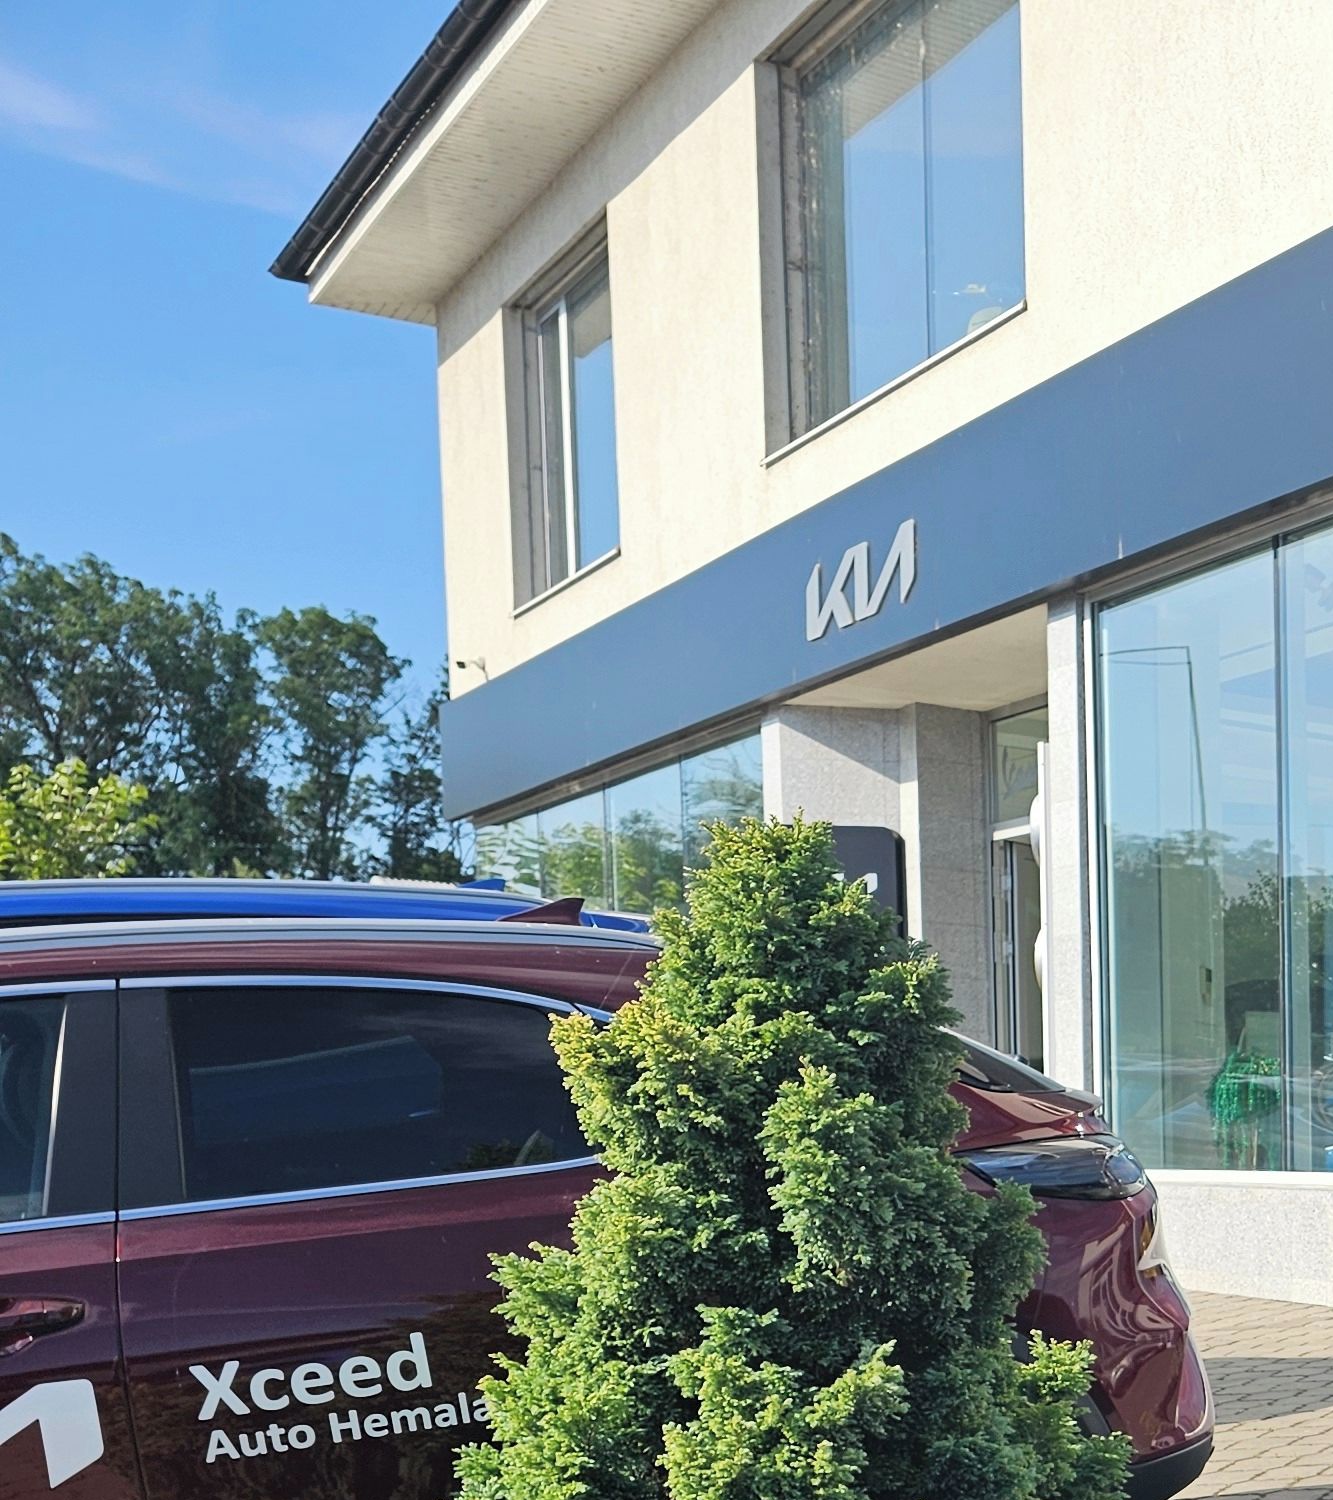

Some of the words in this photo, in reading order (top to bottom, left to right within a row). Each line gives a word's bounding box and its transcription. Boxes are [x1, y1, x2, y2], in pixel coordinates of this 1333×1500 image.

[805, 518, 915, 642] KIA
[188, 1331, 433, 1421] Xceed
[205, 1423, 316, 1464] Auto
[328, 1391, 491, 1444] Hemala
